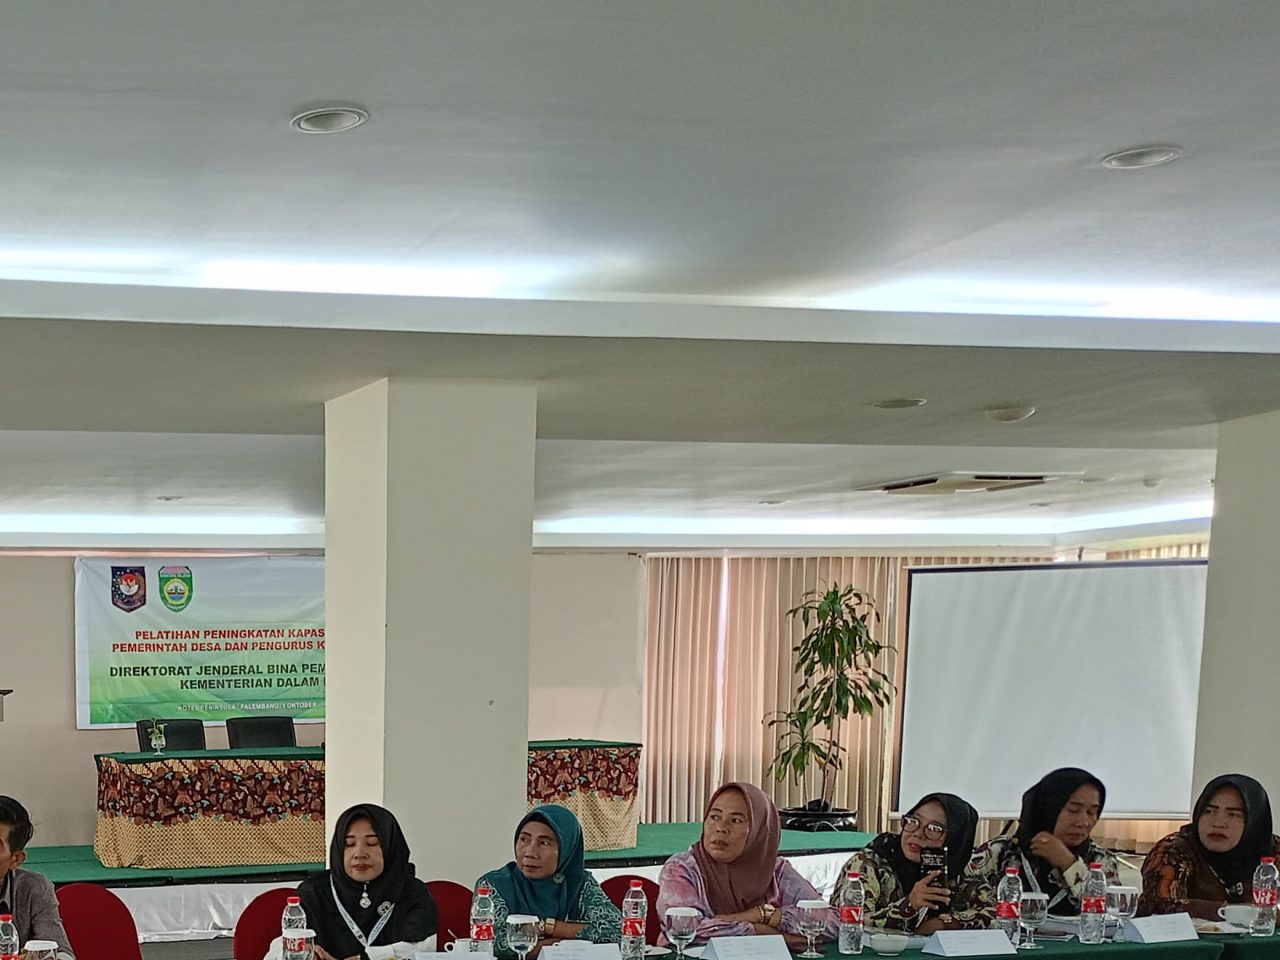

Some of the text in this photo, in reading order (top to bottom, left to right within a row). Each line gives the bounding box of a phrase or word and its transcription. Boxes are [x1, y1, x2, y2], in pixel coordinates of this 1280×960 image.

[135, 628, 325, 640] PELATIHAN PENINGKATAN KAPAS
[112, 643, 187, 652] PEMERINTAH
[191, 642, 222, 652] DESA
[225, 642, 248, 651] DAN
[252, 641, 314, 651] PENGURUS
[110, 666, 193, 677] DIREKTORAT
[196, 664, 263, 676] JENDERAL
[267, 664, 298, 674] BINA
[180, 677, 320, 690] KEMENTERIAN DALAM
